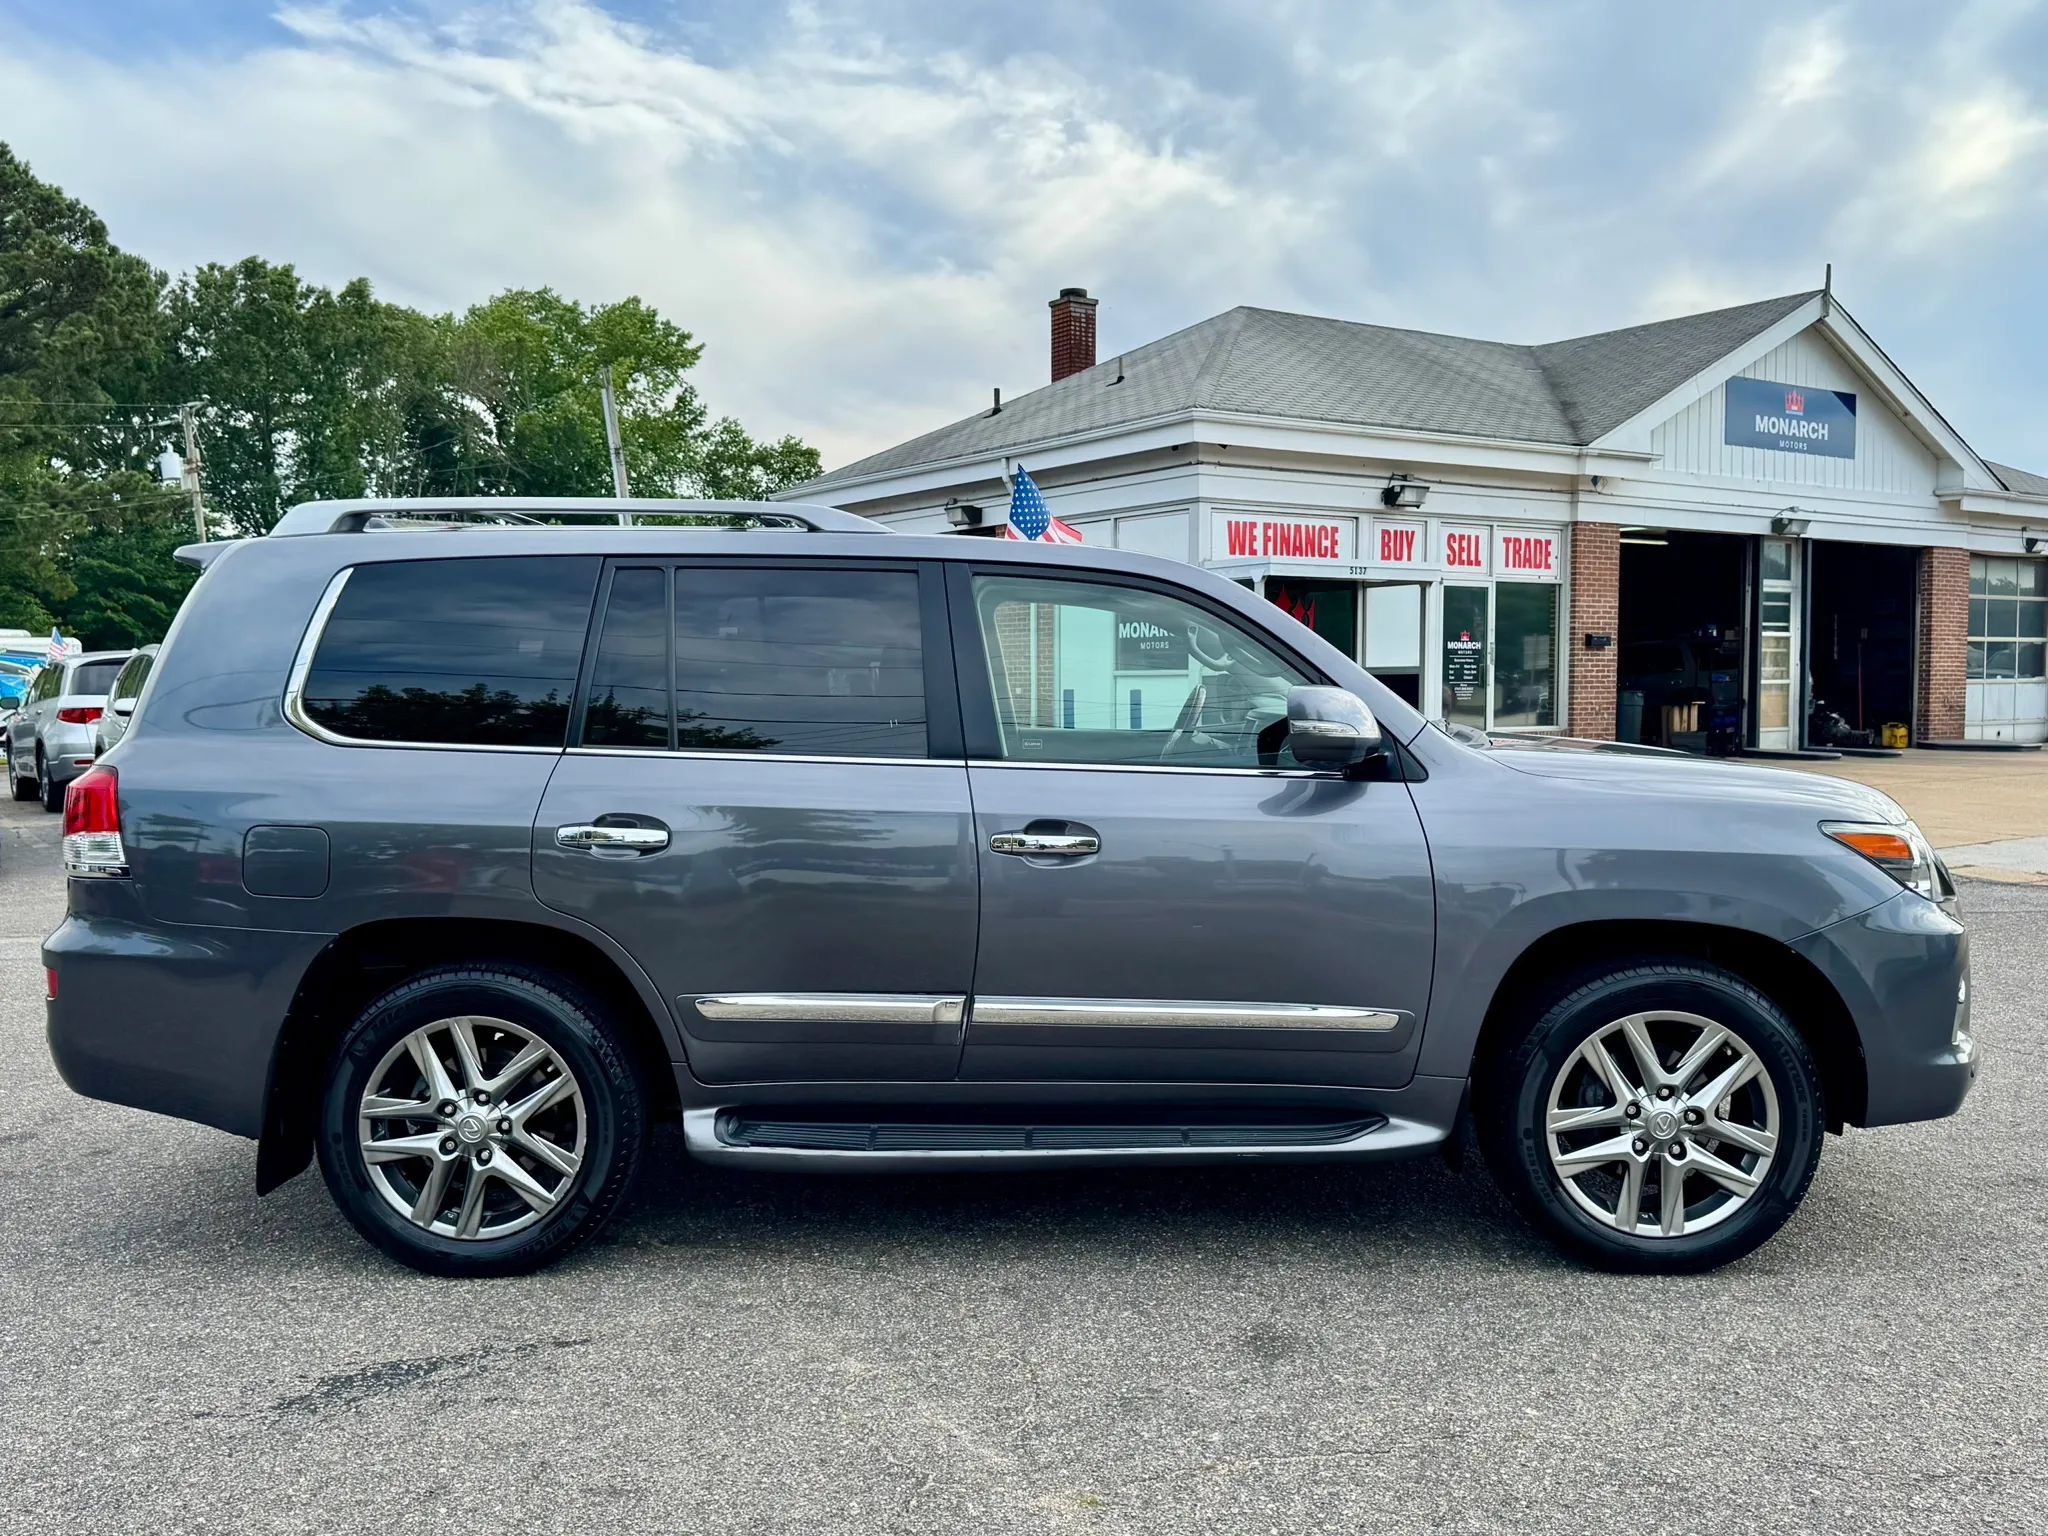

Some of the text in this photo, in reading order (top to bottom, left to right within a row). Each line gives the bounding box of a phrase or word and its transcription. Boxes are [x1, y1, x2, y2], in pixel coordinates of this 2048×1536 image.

[1755, 414, 1828, 440] MONARCH
[1779, 440, 1808, 450] MOTORS
[1227, 520, 1339, 559] WE FINANCE
[1380, 528, 1416, 562] BUY
[1446, 532, 1482, 567] SELL
[1502, 536, 1552, 570] TRADE
[1349, 566, 1367, 575] 5137
[1140, 641, 1169, 649] MOTORS
[1447, 641, 1482, 650] MONARCH
